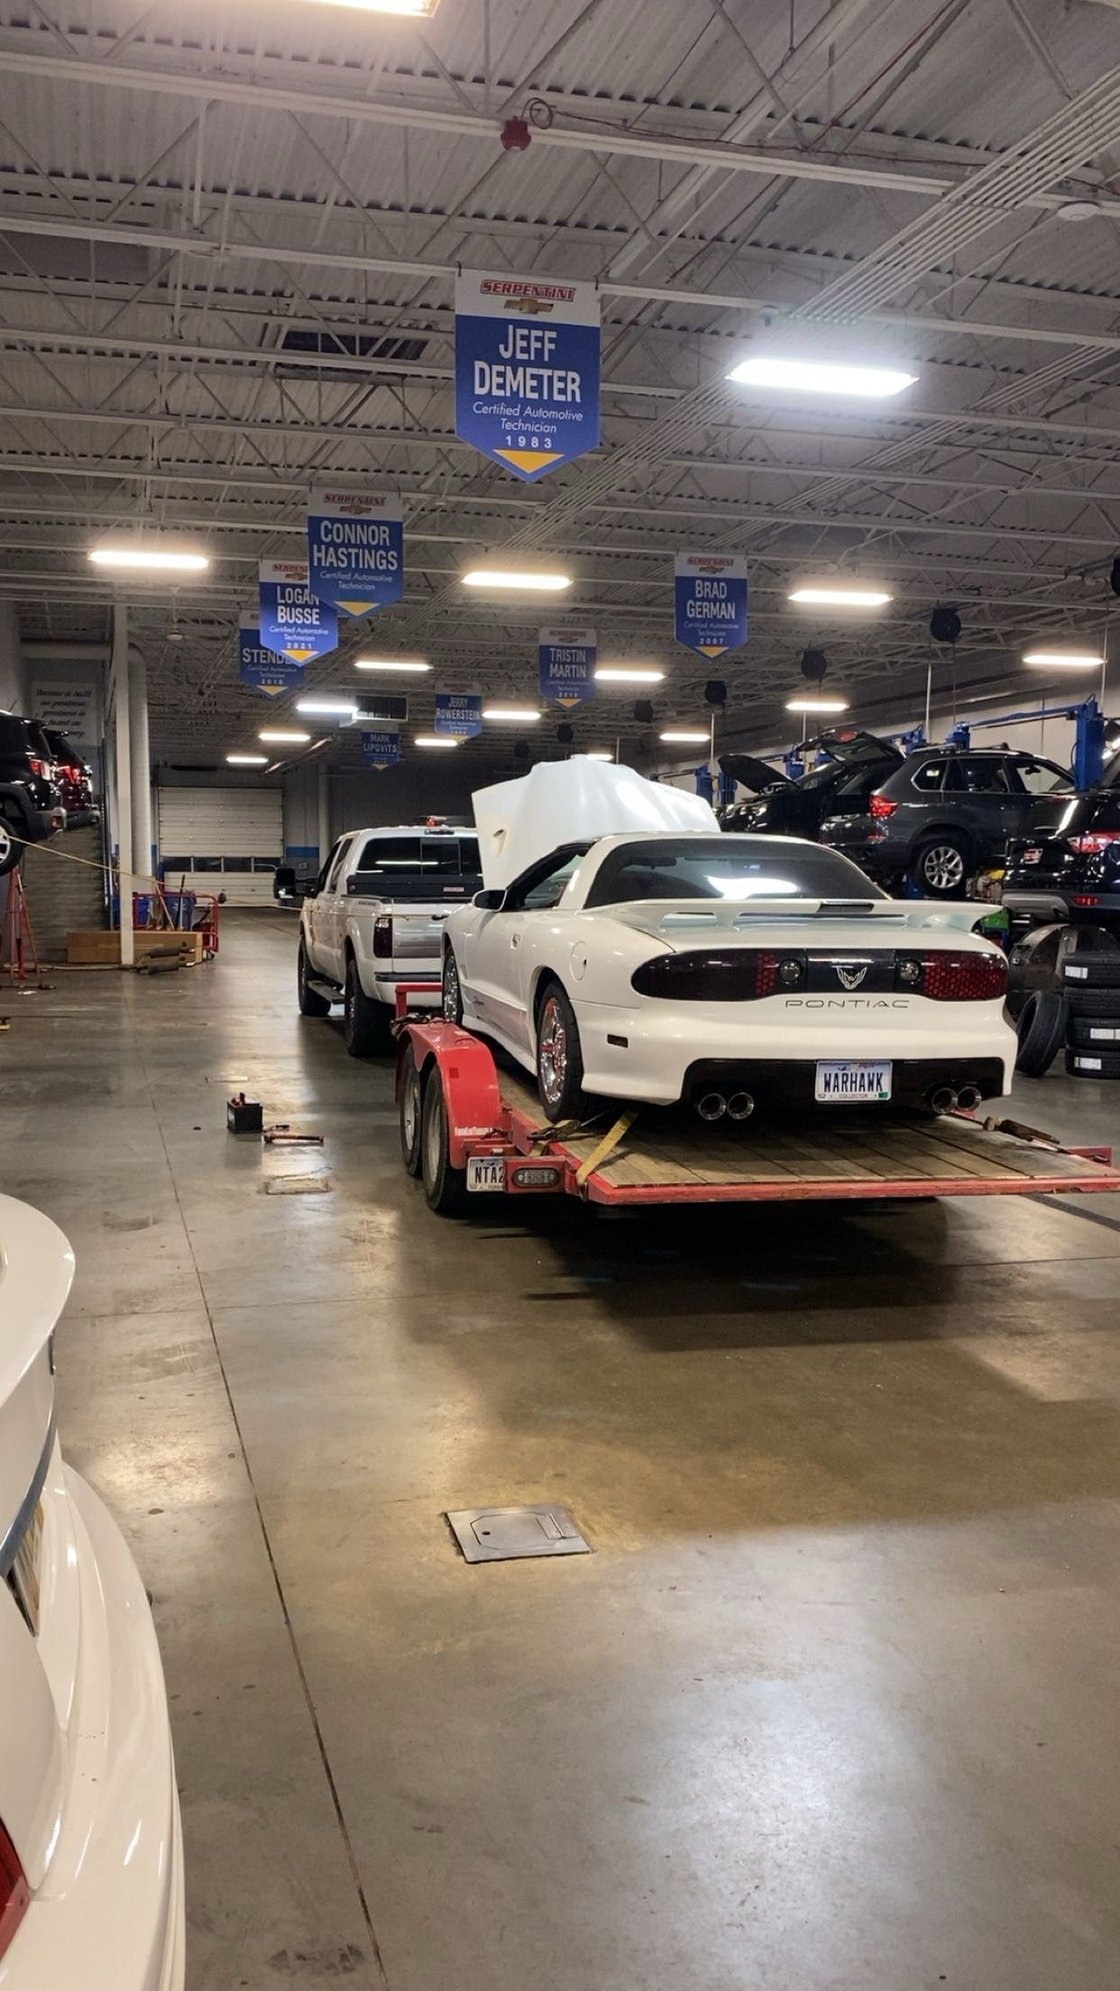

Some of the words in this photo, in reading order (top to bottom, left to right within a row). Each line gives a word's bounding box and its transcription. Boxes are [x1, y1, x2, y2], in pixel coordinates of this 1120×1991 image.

[482, 280, 575, 300] SERPENTINI
[499, 325, 558, 361] JEFF
[474, 360, 581, 402] DEMETER
[472, 401, 520, 417] Certified
[523, 406, 584, 421] Automotive
[500, 418, 557, 433] Technician
[505, 435, 552, 448] 1983
[320, 520, 390, 546] CONNOR
[313, 544, 398, 570] HASTINGS
[320, 571, 351, 580] Certified
[352, 573, 393, 582] Automotive
[338, 581, 376, 590] Technician
[277, 585, 319, 605] LOGAN
[695, 580, 728, 599] BRAD
[277, 605, 320, 625] BUSSE
[686, 600, 736, 620] GERMAN
[242, 648, 292, 665] STEND
[549, 647, 587, 663] TRISTIN
[550, 663, 586, 678] MARTIN
[785, 1000, 910, 1009] PONTIAC
[824, 1072, 884, 1092] WARHAWK
